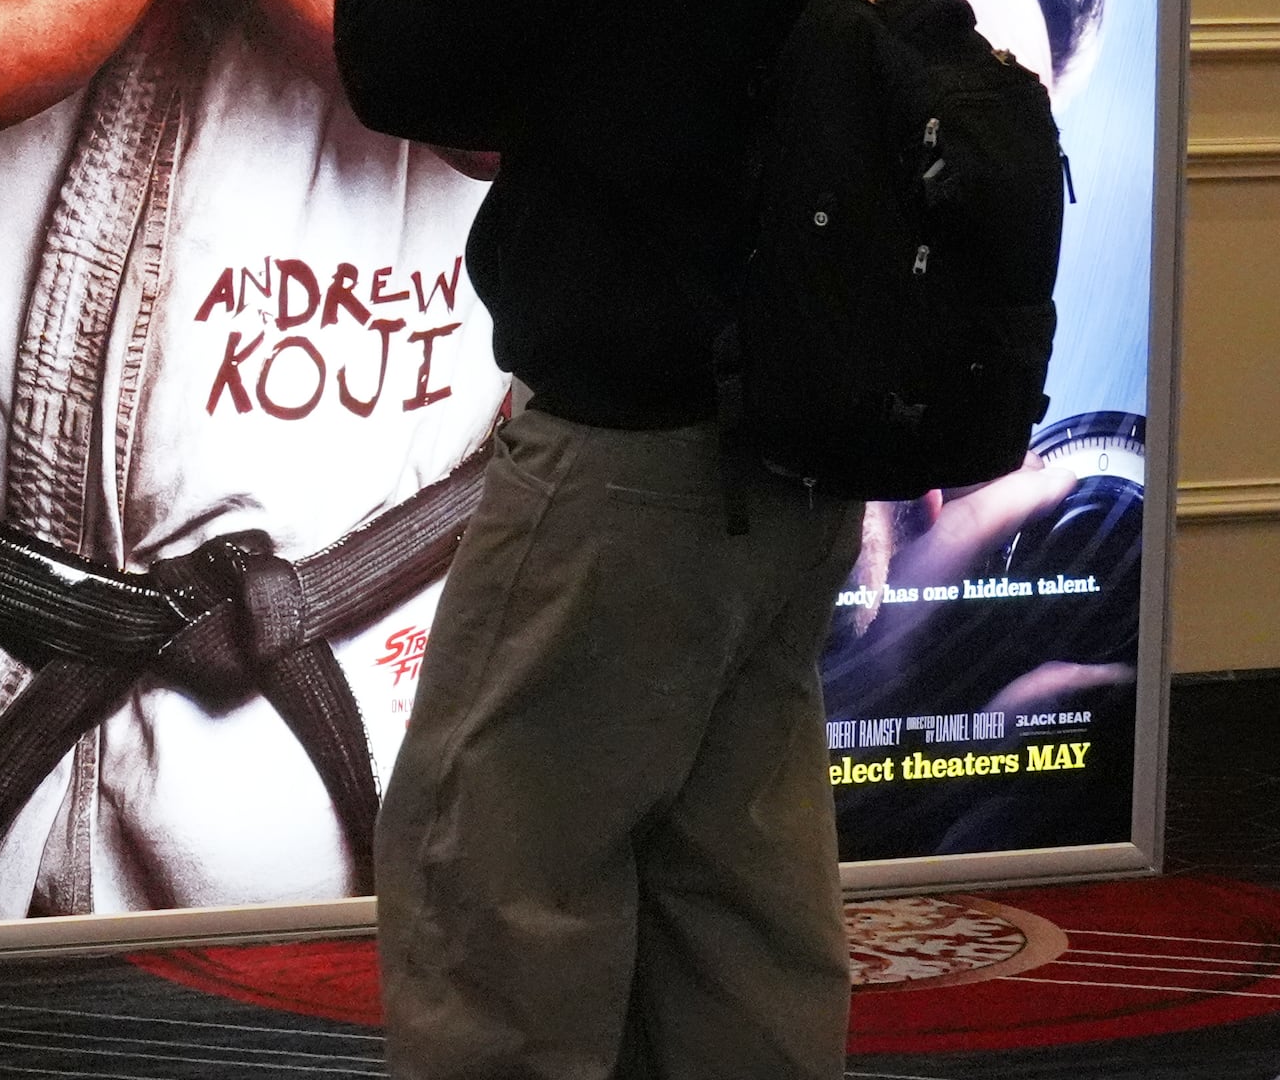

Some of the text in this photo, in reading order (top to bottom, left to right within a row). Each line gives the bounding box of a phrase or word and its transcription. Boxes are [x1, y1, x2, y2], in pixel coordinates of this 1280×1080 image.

[194, 256, 464, 330] ANDREW
[205, 317, 464, 421] KOJI
[882, 584, 919, 604] has
[923, 586, 960, 602] one
[963, 578, 1033, 600] hidden
[1038, 575, 1101, 595] talent.
[373, 625, 429, 666] STR
[826, 712, 1005, 750] OBERT RAMSEY DIRECTED BY DANIEL ROHER
[1058, 711, 1092, 724] BEAR
[829, 742, 1091, 786] elect theaters MAY
